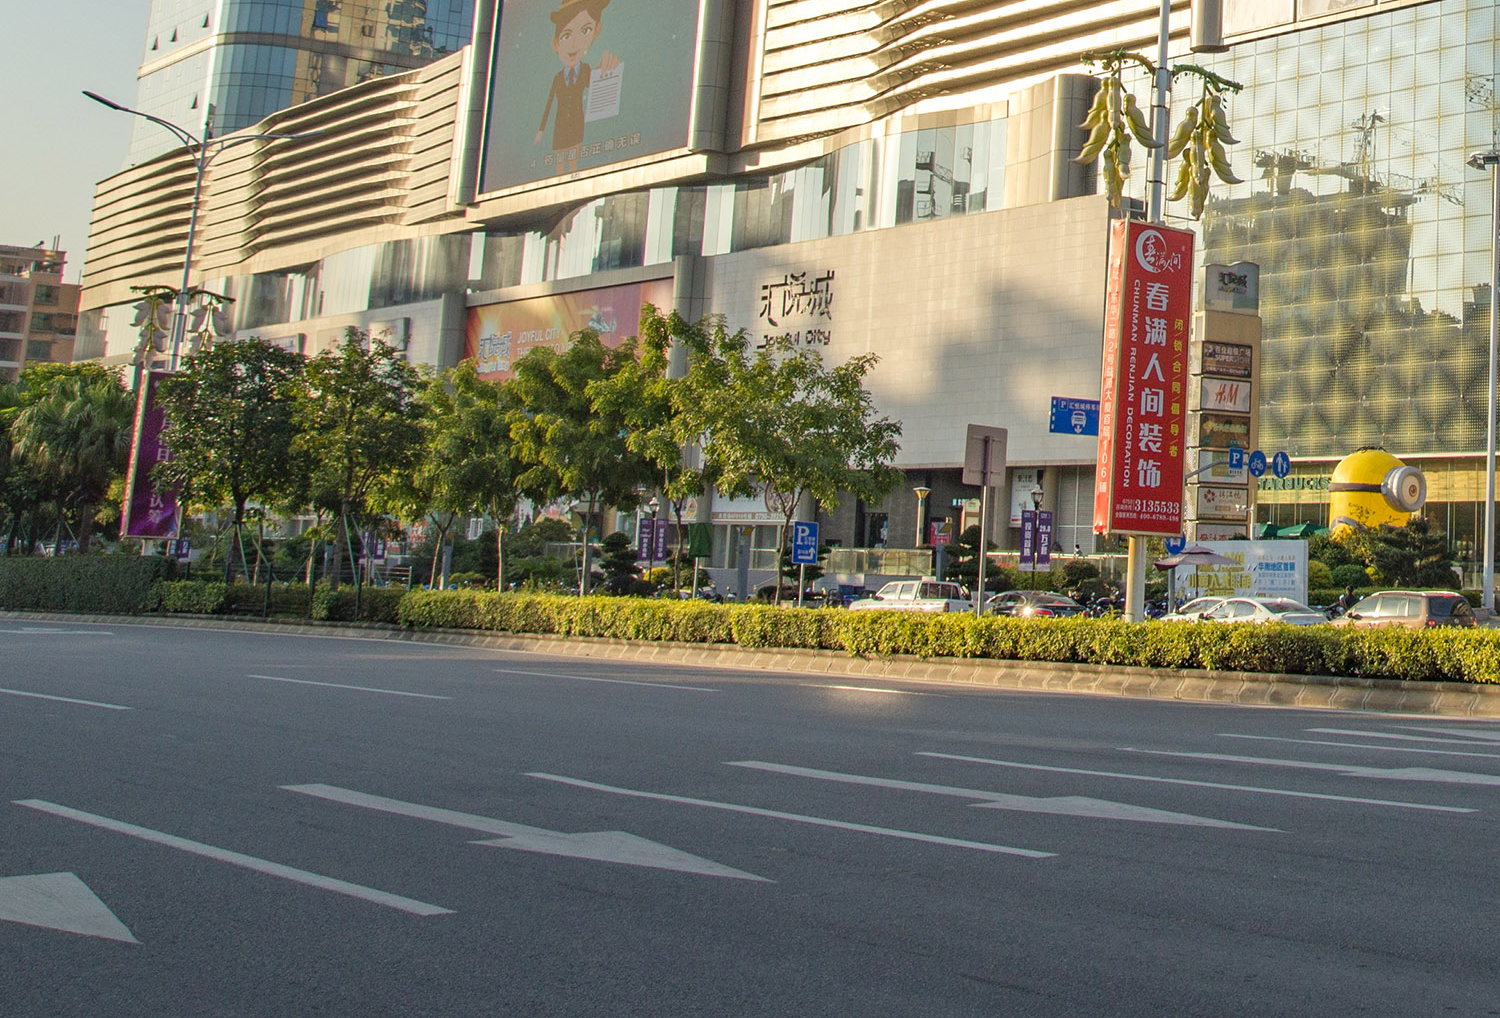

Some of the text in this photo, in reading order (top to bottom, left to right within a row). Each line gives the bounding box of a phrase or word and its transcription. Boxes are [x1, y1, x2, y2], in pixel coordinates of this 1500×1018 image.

[1123, 278, 1141, 488] CHUNMAN RENJIAN DECORATION
[1137, 282, 1170, 489] 春满人间装饰
[1231, 452, 1241, 464] P
[1257, 476, 1330, 491] TARBUCKS
[1134, 498, 1180, 515] 3135533
[796, 525, 810, 546] P
